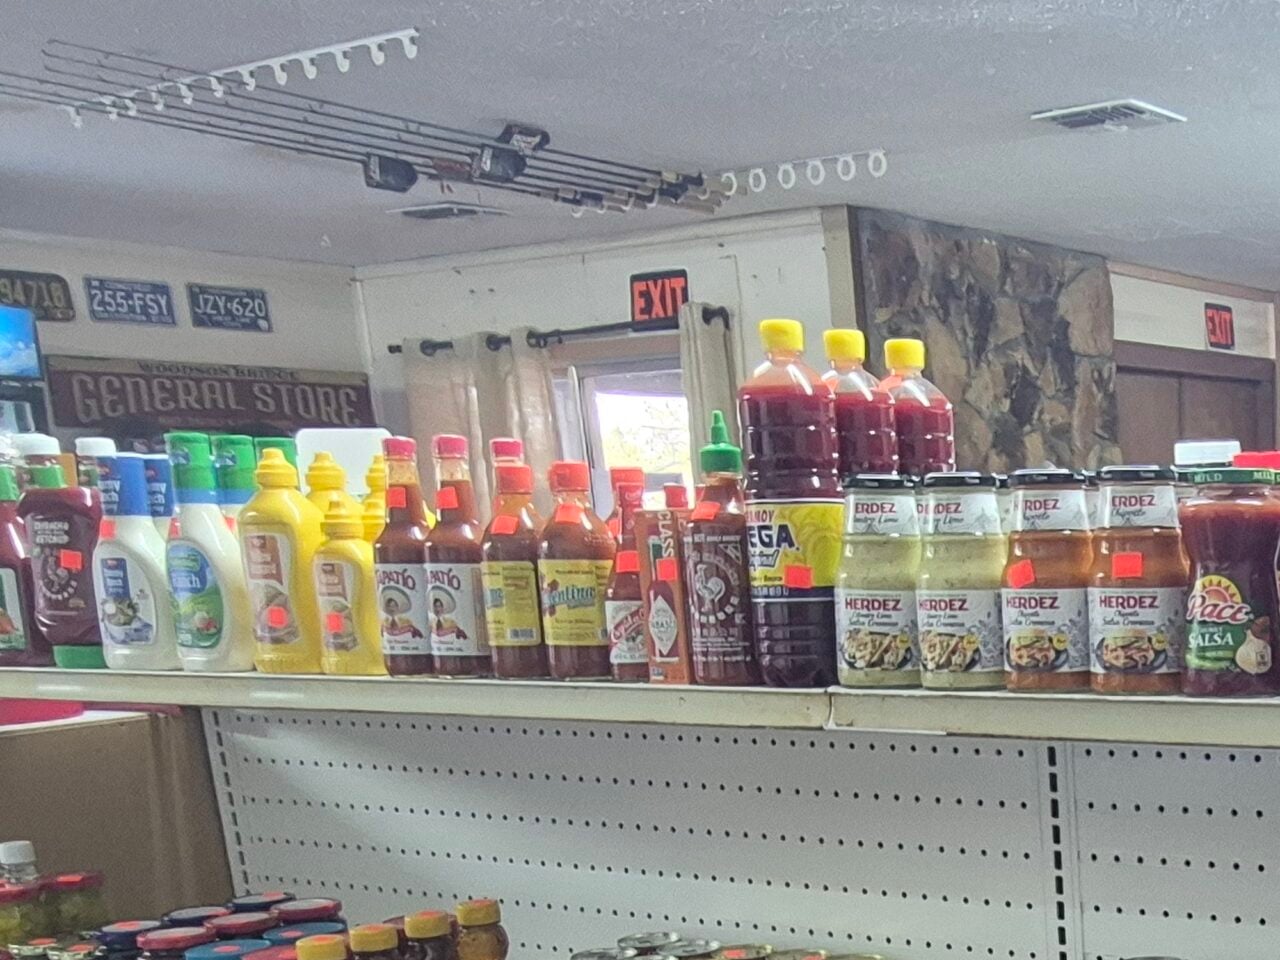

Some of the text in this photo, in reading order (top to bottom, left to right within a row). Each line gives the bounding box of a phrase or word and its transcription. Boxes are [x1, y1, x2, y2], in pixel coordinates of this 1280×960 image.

[633, 278, 686, 320] EXIT
[1205, 307, 1234, 346] EXIT
[71, 373, 364, 427] GENERAL STORE
[845, 598, 902, 612] HERDEZ
[1099, 595, 1159, 609] HERDEZ
[1188, 591, 1250, 624] Pace
[1188, 632, 1235, 648] SALSA
